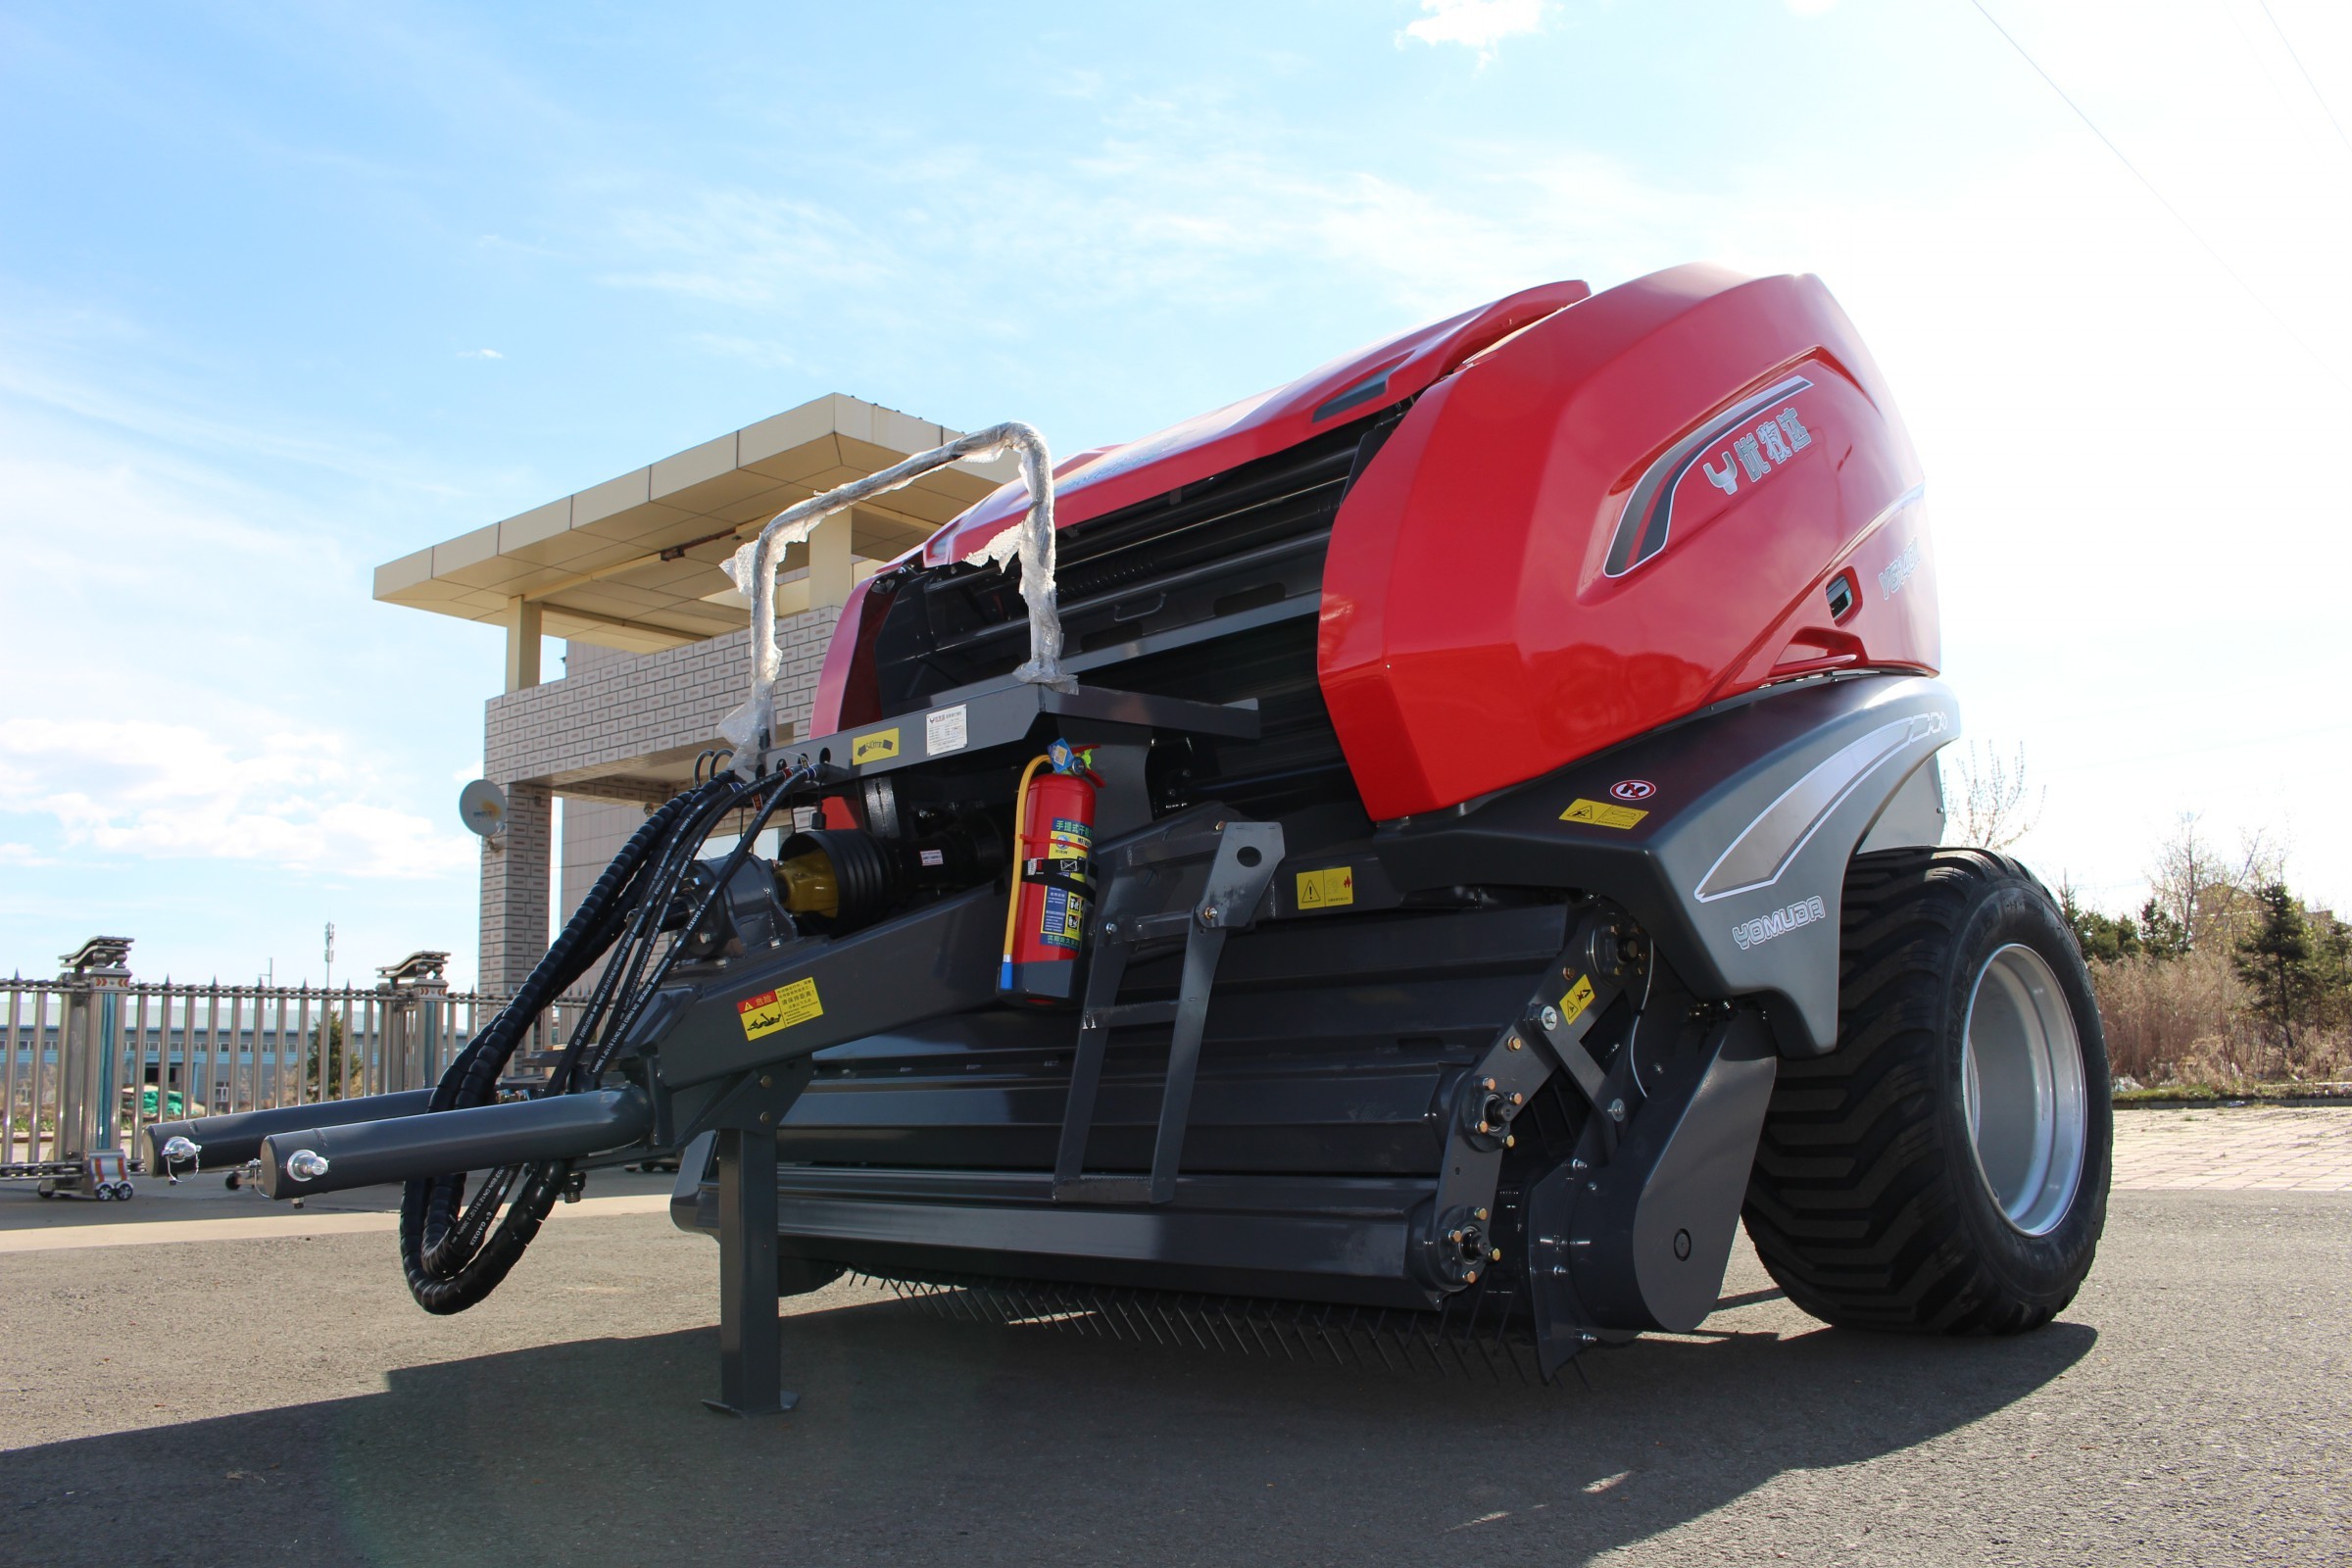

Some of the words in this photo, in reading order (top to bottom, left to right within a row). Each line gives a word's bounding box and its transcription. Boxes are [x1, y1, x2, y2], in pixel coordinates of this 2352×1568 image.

[1734, 408, 1811, 483] 优牧达
[685, 909, 702, 930] GAOXIN
[1732, 896, 1825, 950] YOMUDA
[756, 994, 772, 1006] 危险
[468, 1220, 486, 1247] GAOXIN
